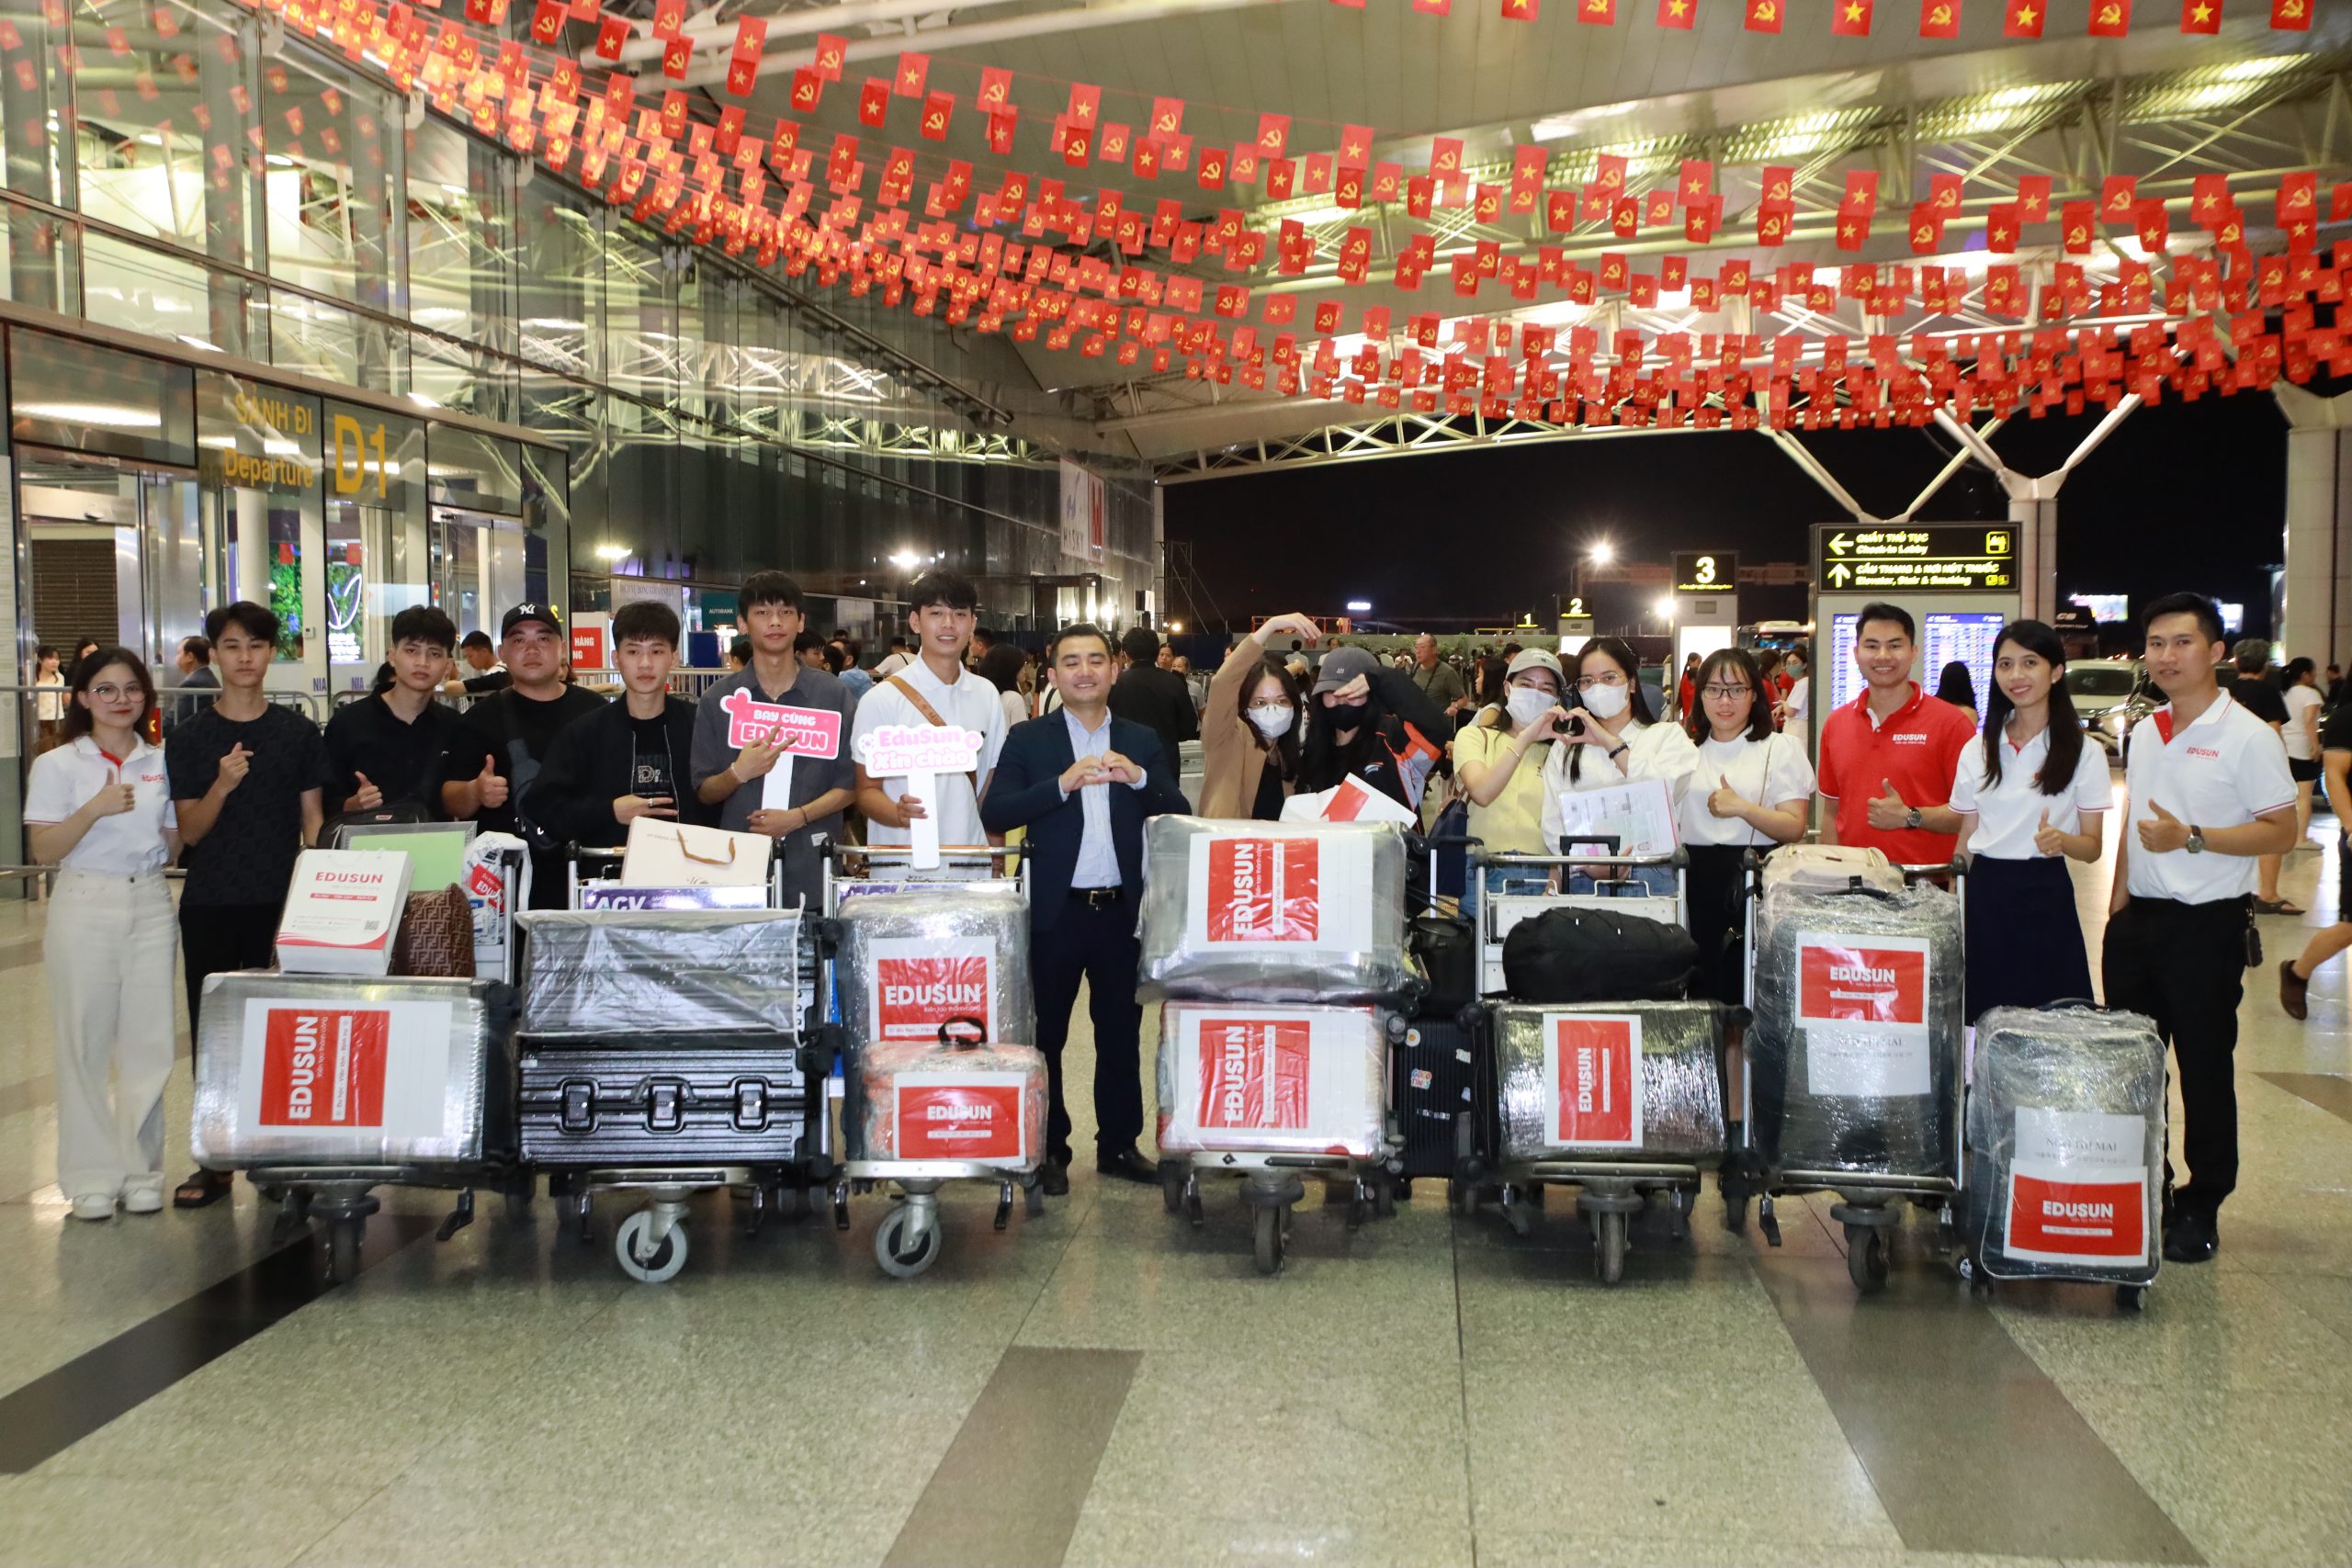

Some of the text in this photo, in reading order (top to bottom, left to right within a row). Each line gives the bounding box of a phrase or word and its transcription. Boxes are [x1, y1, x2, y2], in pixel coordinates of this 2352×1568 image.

[234, 384, 313, 435] SẢNH ĐI
[334, 413, 387, 500] D1
[223, 446, 313, 489] Departure
[1695, 556, 1716, 584] 3
[1569, 597, 1583, 614] 2
[1523, 613, 1532, 626] 1
[574, 635, 594, 647] HÀNG
[753, 709, 817, 727] BAY CÙNG
[879, 728, 960, 747] EduSun
[1893, 733, 1927, 741] EDUSUN
[873, 747, 971, 772] Xin chào
[2187, 746, 2220, 758] EDUSUN
[315, 871, 383, 884] EDUSUN
[1234, 843, 1254, 935] EDUSUN
[1829, 966, 1895, 984] EDUSUN
[885, 984, 981, 1006] EDUSUN
[288, 1015, 319, 1120] EDUSUN
[1224, 1025, 1246, 1122] EDUSUN
[1577, 1047, 1593, 1113] EDUSUN
[927, 1105, 992, 1121] EDUSUN
[2042, 1200, 2113, 1218] EDUSUN
